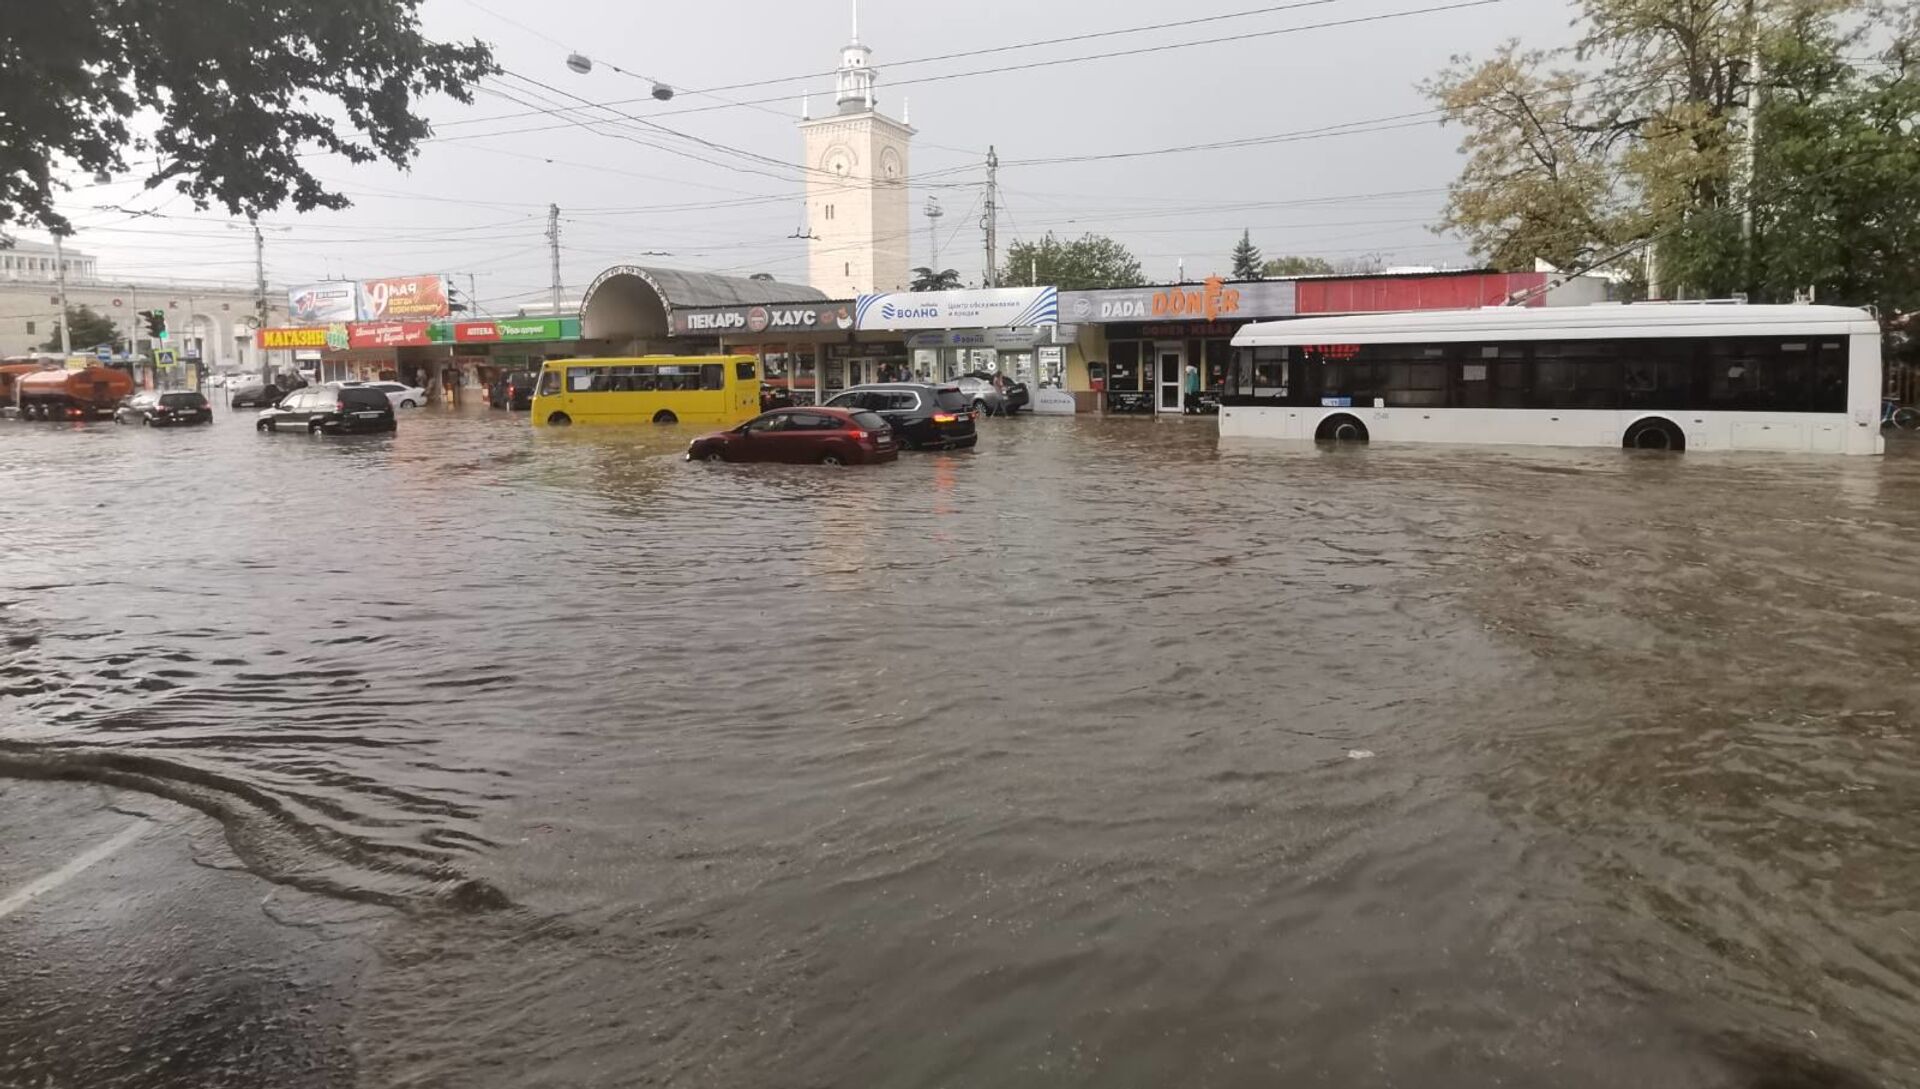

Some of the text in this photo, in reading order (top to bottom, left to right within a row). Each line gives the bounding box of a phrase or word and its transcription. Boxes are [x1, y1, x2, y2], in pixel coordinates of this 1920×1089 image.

[373, 282, 417, 316] 9 МАЯ
[1101, 300, 1146, 317] DADA
[687, 312, 745, 329] ПЕКАРЬ
[771, 310, 816, 326] ХАУС
[264, 329, 326, 347] МАГАЗИН
